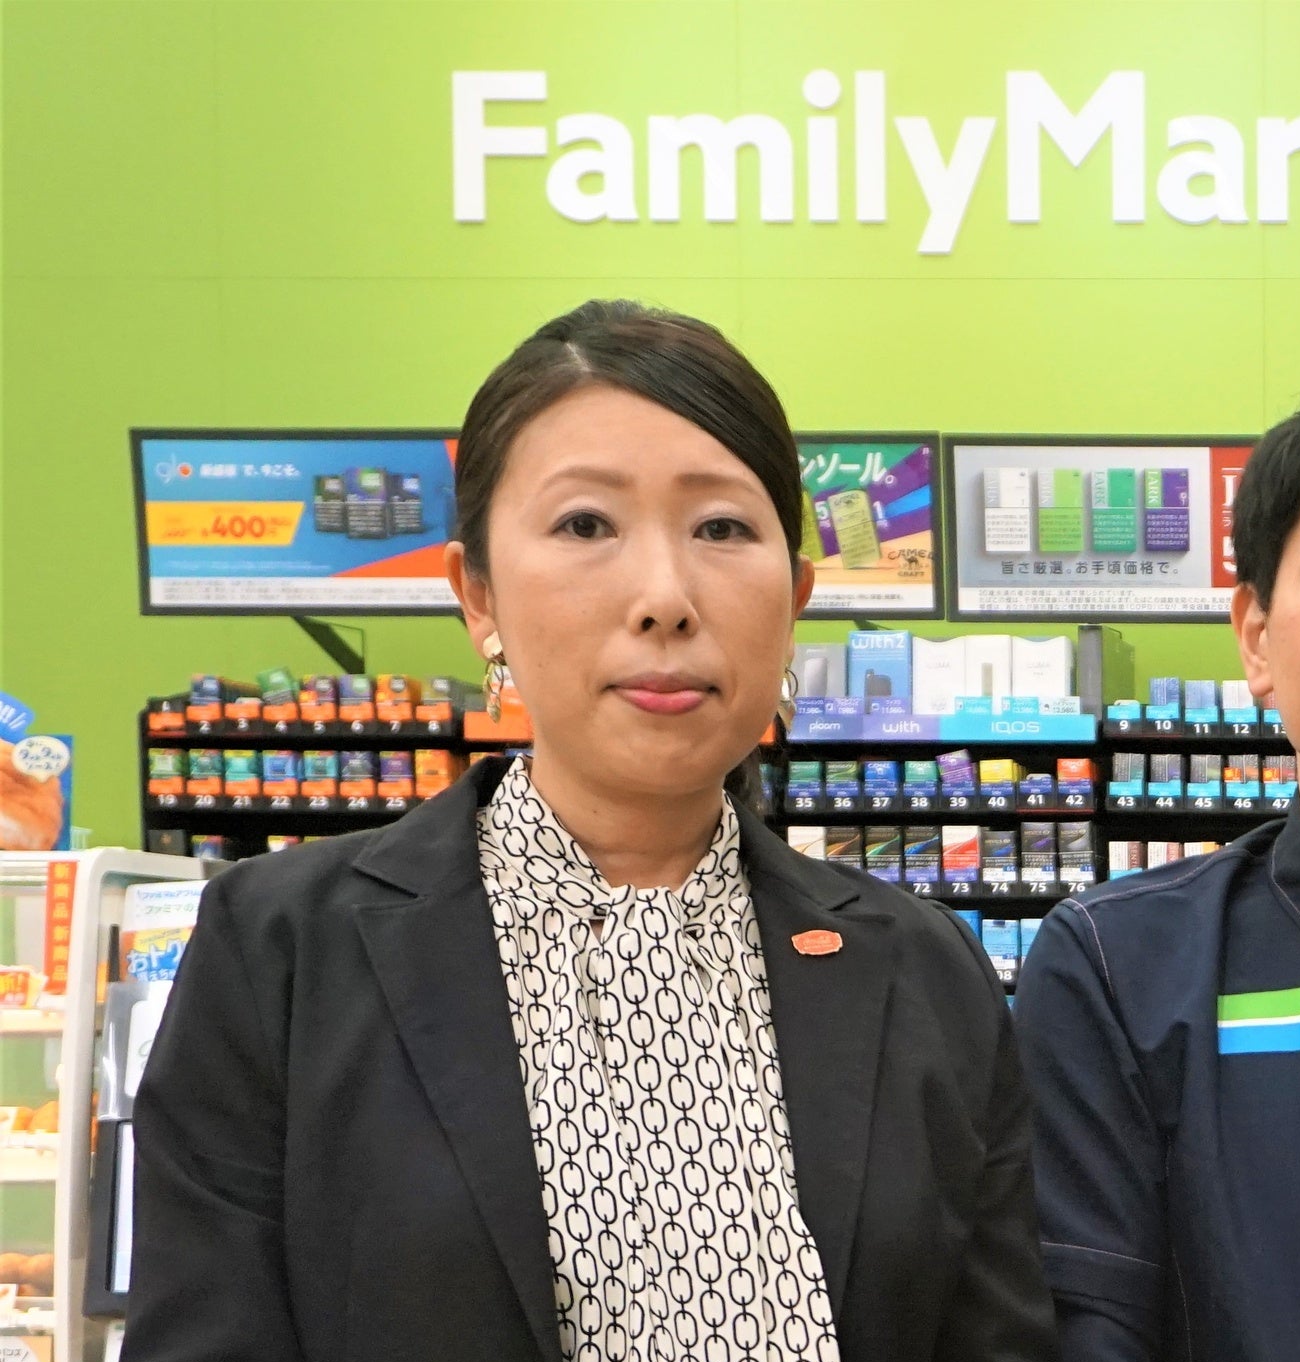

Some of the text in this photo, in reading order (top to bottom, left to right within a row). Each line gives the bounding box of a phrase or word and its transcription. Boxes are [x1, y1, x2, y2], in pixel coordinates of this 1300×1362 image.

[1001, 560, 1180, 575] 旨さ厳選。お手頃価格で。
[882, 718, 921, 733] with
[991, 720, 1041, 734] IQOS
[1119, 721, 1129, 730] 9
[1154, 720, 1172, 730] 10
[1193, 724, 1210, 733] 11
[1232, 724, 1249, 734] 12
[347, 797, 369, 809] 24
[385, 797, 407, 809] 25
[795, 798, 813, 808] 35
[834, 798, 852, 808] 36
[872, 798, 889, 808] 37
[911, 798, 928, 808] 38
[949, 798, 967, 808] 39
[987, 797, 1006, 808] 40
[1027, 795, 1044, 805] 41
[1065, 795, 1083, 805] 42
[1117, 797, 1135, 807] 43
[1155, 797, 1174, 808] 44
[1194, 798, 1213, 808] 45
[1233, 798, 1252, 809] 46
[1272, 799, 1290, 809] 47
[913, 883, 931, 893] 72
[952, 883, 970, 893] 73
[991, 883, 1009, 893] 74
[1029, 883, 1047, 893] 75
[1067, 883, 1086, 893] 76
